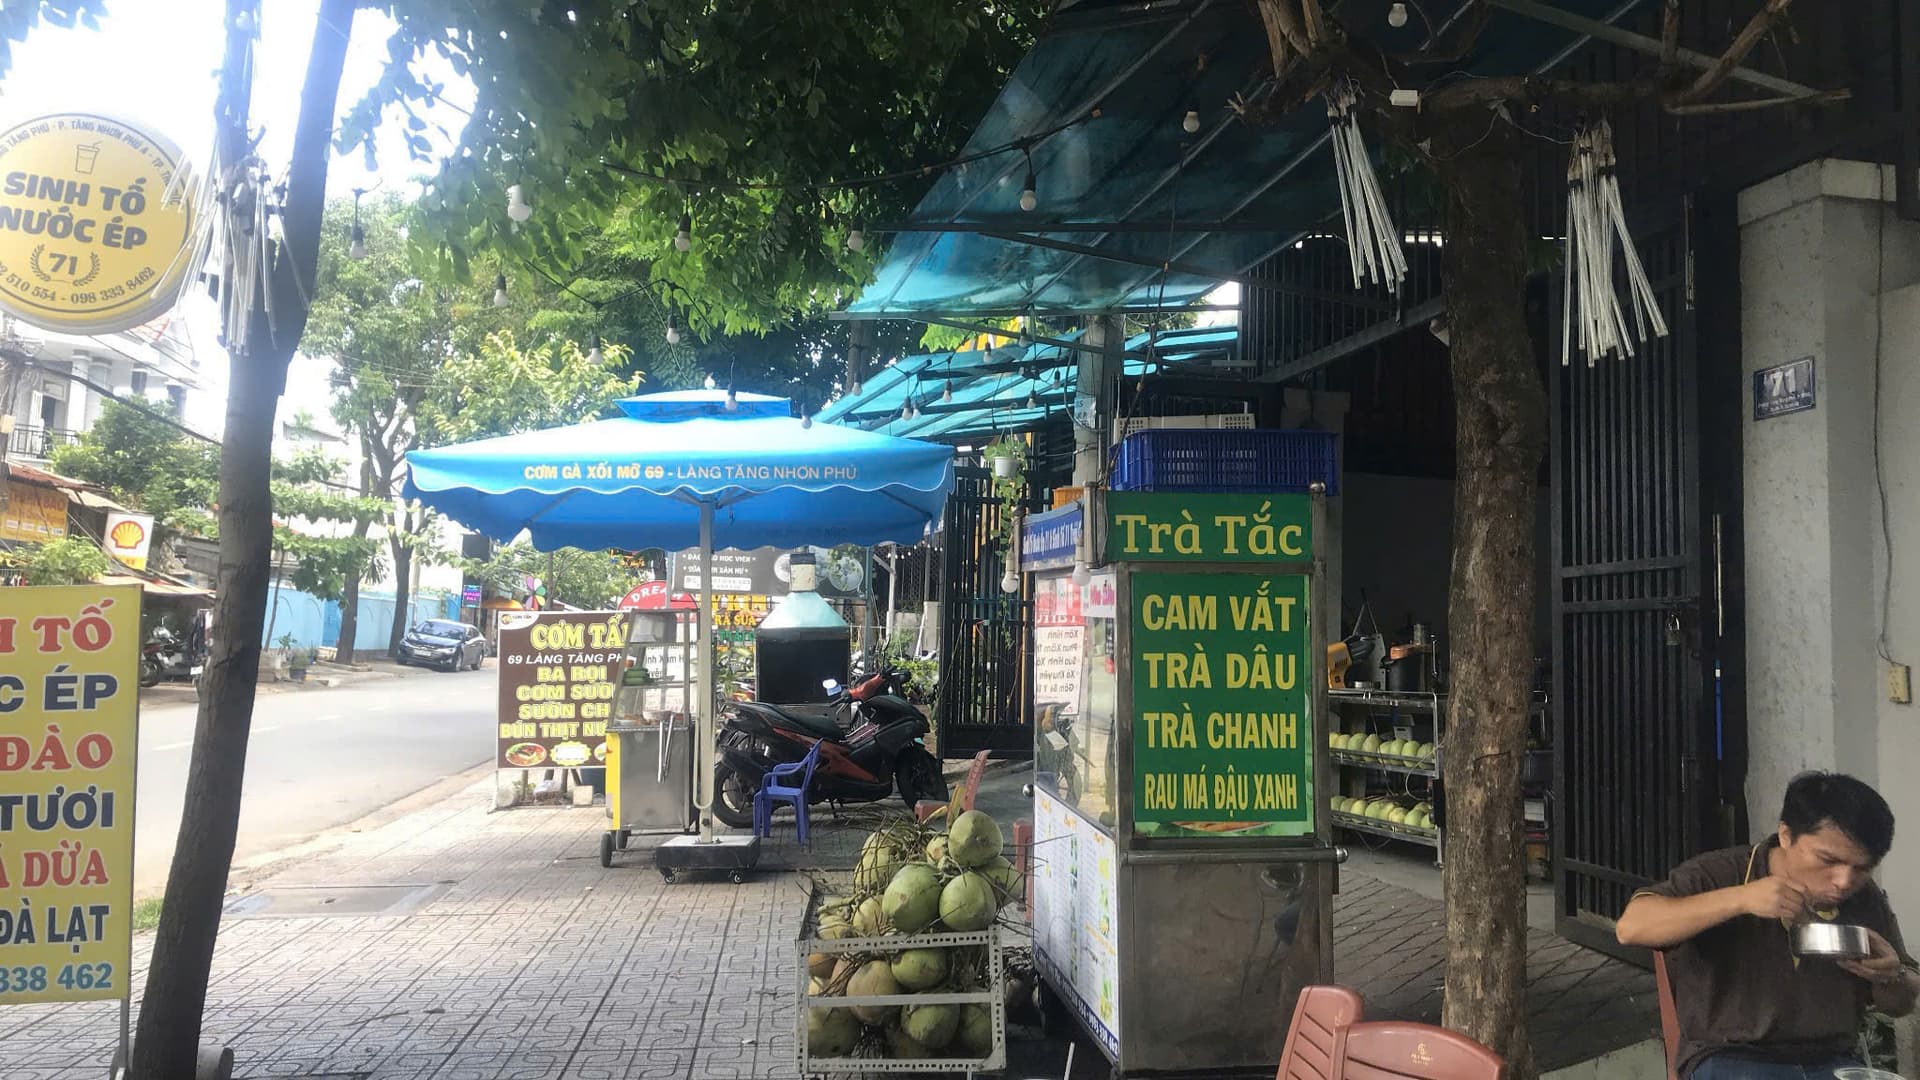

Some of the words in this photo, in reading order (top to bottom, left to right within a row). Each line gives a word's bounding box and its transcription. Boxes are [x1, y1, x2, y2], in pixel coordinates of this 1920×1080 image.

[4, 171, 90, 207] SINH
[100, 177, 147, 215] TỐ
[0, 206, 96, 243] NƯỚC
[102, 216, 147, 250] ÉP
[6, 273, 30, 292] 510
[32, 286, 56, 301] 554
[70, 293, 97, 304] 098
[100, 285, 125, 301] 333
[126, 267, 156, 290] 8462
[49, 252, 78, 275] 71
[524, 464, 558, 480] CƠM
[562, 463, 582, 480] GÀ
[586, 461, 612, 480] XỐI
[617, 462, 640, 479] MỠ
[644, 465, 664, 480] 69
[677, 463, 721, 480] LÀNG
[725, 463, 769, 480] TĂNG
[1115, 509, 1203, 554] Trà
[1215, 500, 1302, 556] Tắc
[33, 598, 114, 652] TỐ
[1142, 594, 1217, 631] CAM
[1229, 581, 1296, 632] VẮT
[530, 619, 586, 650] CƠM
[507, 655, 523, 664] 69
[526, 652, 563, 664] LÀNG
[568, 652, 603, 664] TĂNG
[607, 653, 622, 663] PH
[537, 666, 566, 682] BA
[1142, 642, 1212, 688] TRÀ
[1226, 643, 1296, 690] DÂU
[44, 665, 118, 711] ÉP
[516, 683, 565, 701] CƠM
[570, 681, 616, 700] SƯỜ
[0, 724, 113, 771] ĐÀO
[499, 720, 536, 738] BÚN
[539, 722, 580, 740] THỊT
[1143, 702, 1197, 748] TRÀ
[1206, 712, 1297, 749] CHANH
[0, 785, 114, 832] TƯƠI
[1144, 773, 1177, 809] RAU
[1183, 764, 1209, 809] MÁ
[1214, 764, 1248, 817] ĐẬU
[1254, 773, 1297, 810] XANH
[22, 840, 109, 887] DỪA
[48, 905, 110, 953] LẠT
[57, 963, 112, 990] 462
